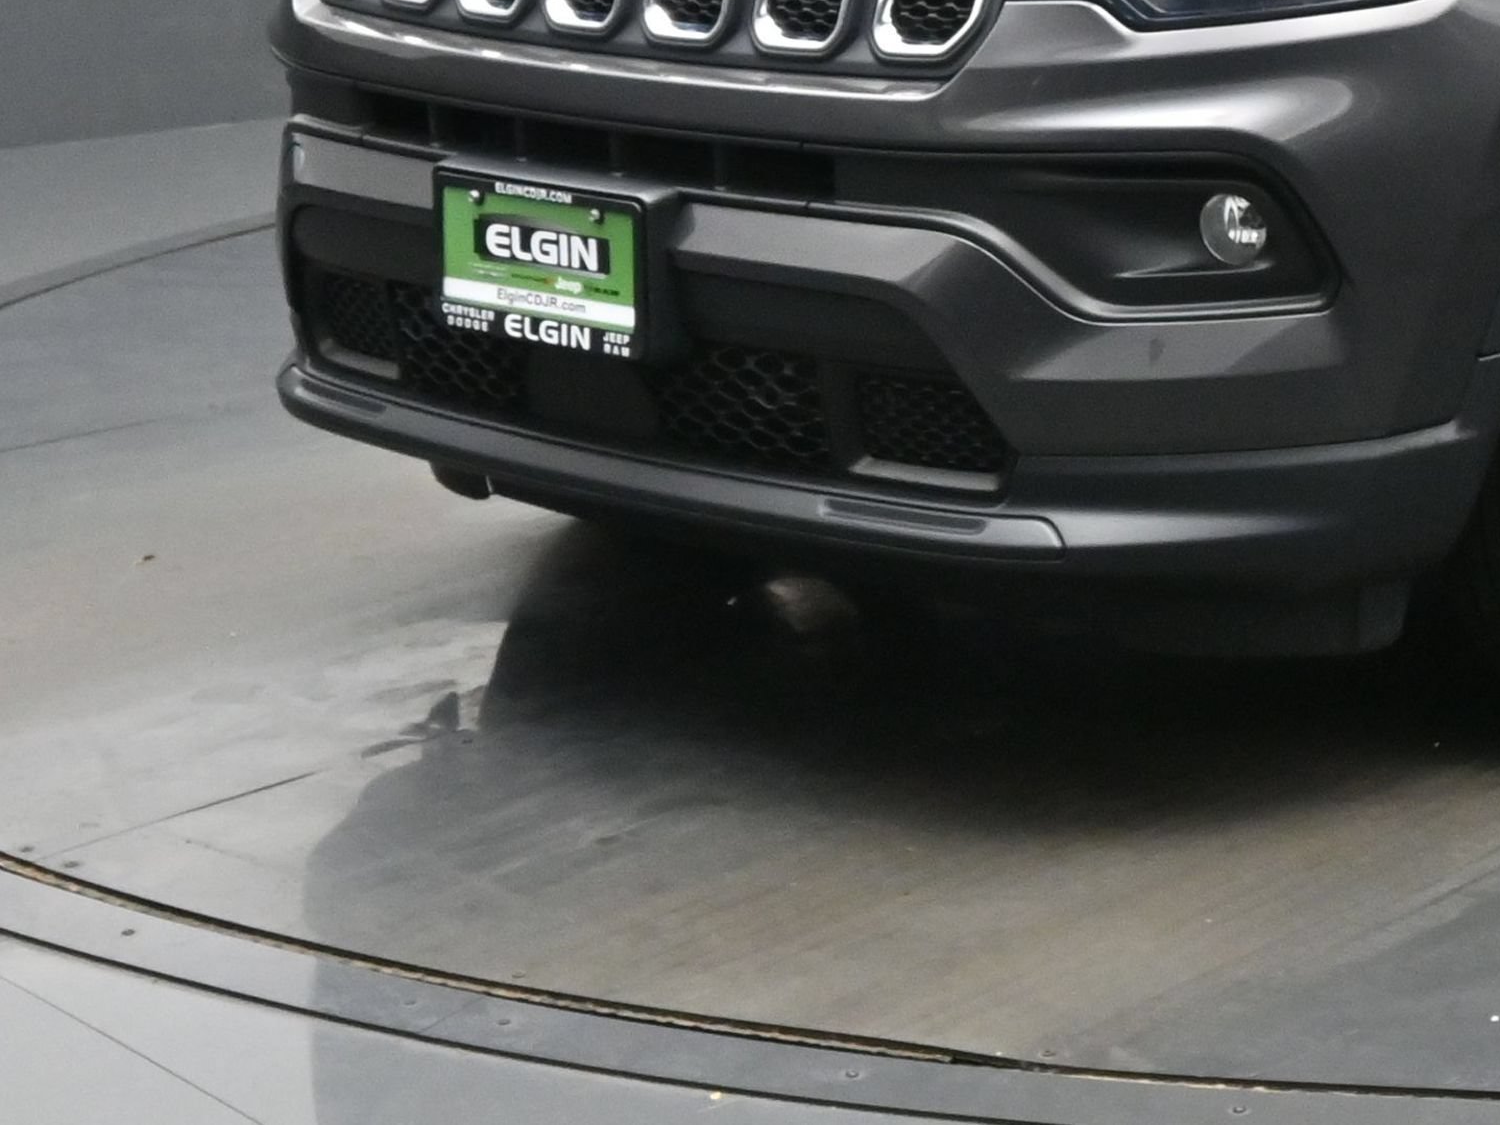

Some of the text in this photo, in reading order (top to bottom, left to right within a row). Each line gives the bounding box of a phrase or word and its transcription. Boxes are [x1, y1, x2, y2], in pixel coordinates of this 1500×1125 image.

[485, 223, 599, 272] ELGIN
[496, 287, 587, 313] ElginCDJR.com
[441, 303, 495, 321] CHRYSLER
[447, 315, 489, 332] DODGE
[504, 313, 591, 351] ELGIN
[603, 332, 630, 344] JEEP
[603, 344, 630, 357] RAM
